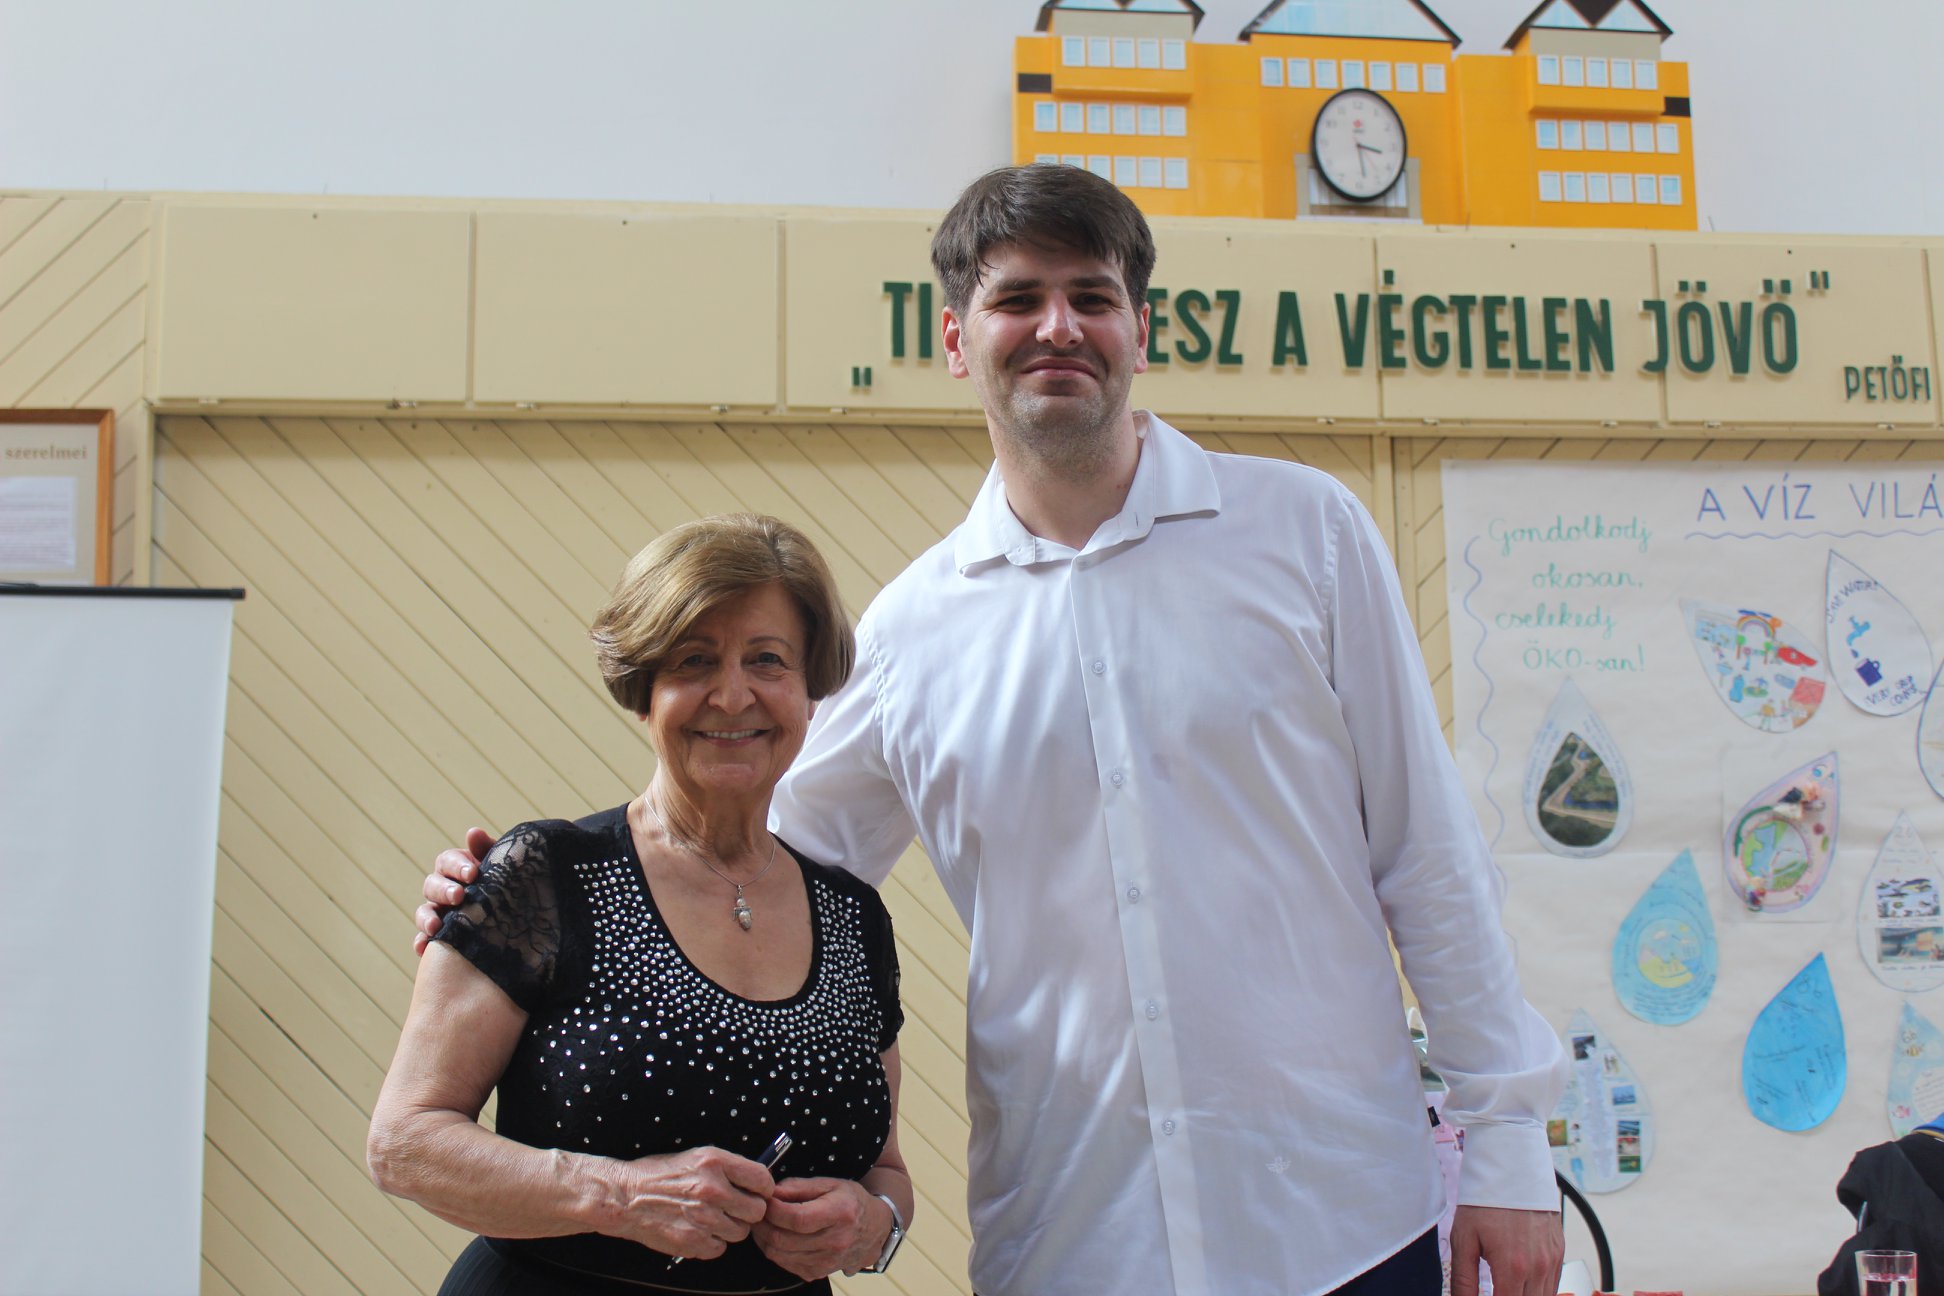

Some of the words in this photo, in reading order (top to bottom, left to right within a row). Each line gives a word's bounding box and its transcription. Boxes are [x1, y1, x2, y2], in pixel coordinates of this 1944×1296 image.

[1147, 288, 1243, 365] ESZ
[1273, 291, 1308, 367] A
[1334, 269, 1614, 373] VÉGTELEN
[5, 444, 88, 460] szerelmei
[1697, 487, 1726, 522] A
[1742, 472, 1816, 521] VÍZ
[1488, 514, 1652, 557] Gondolkodj
[1495, 602, 1615, 640] cselekedj
[1522, 640, 1646, 672] ÖKO-san!
